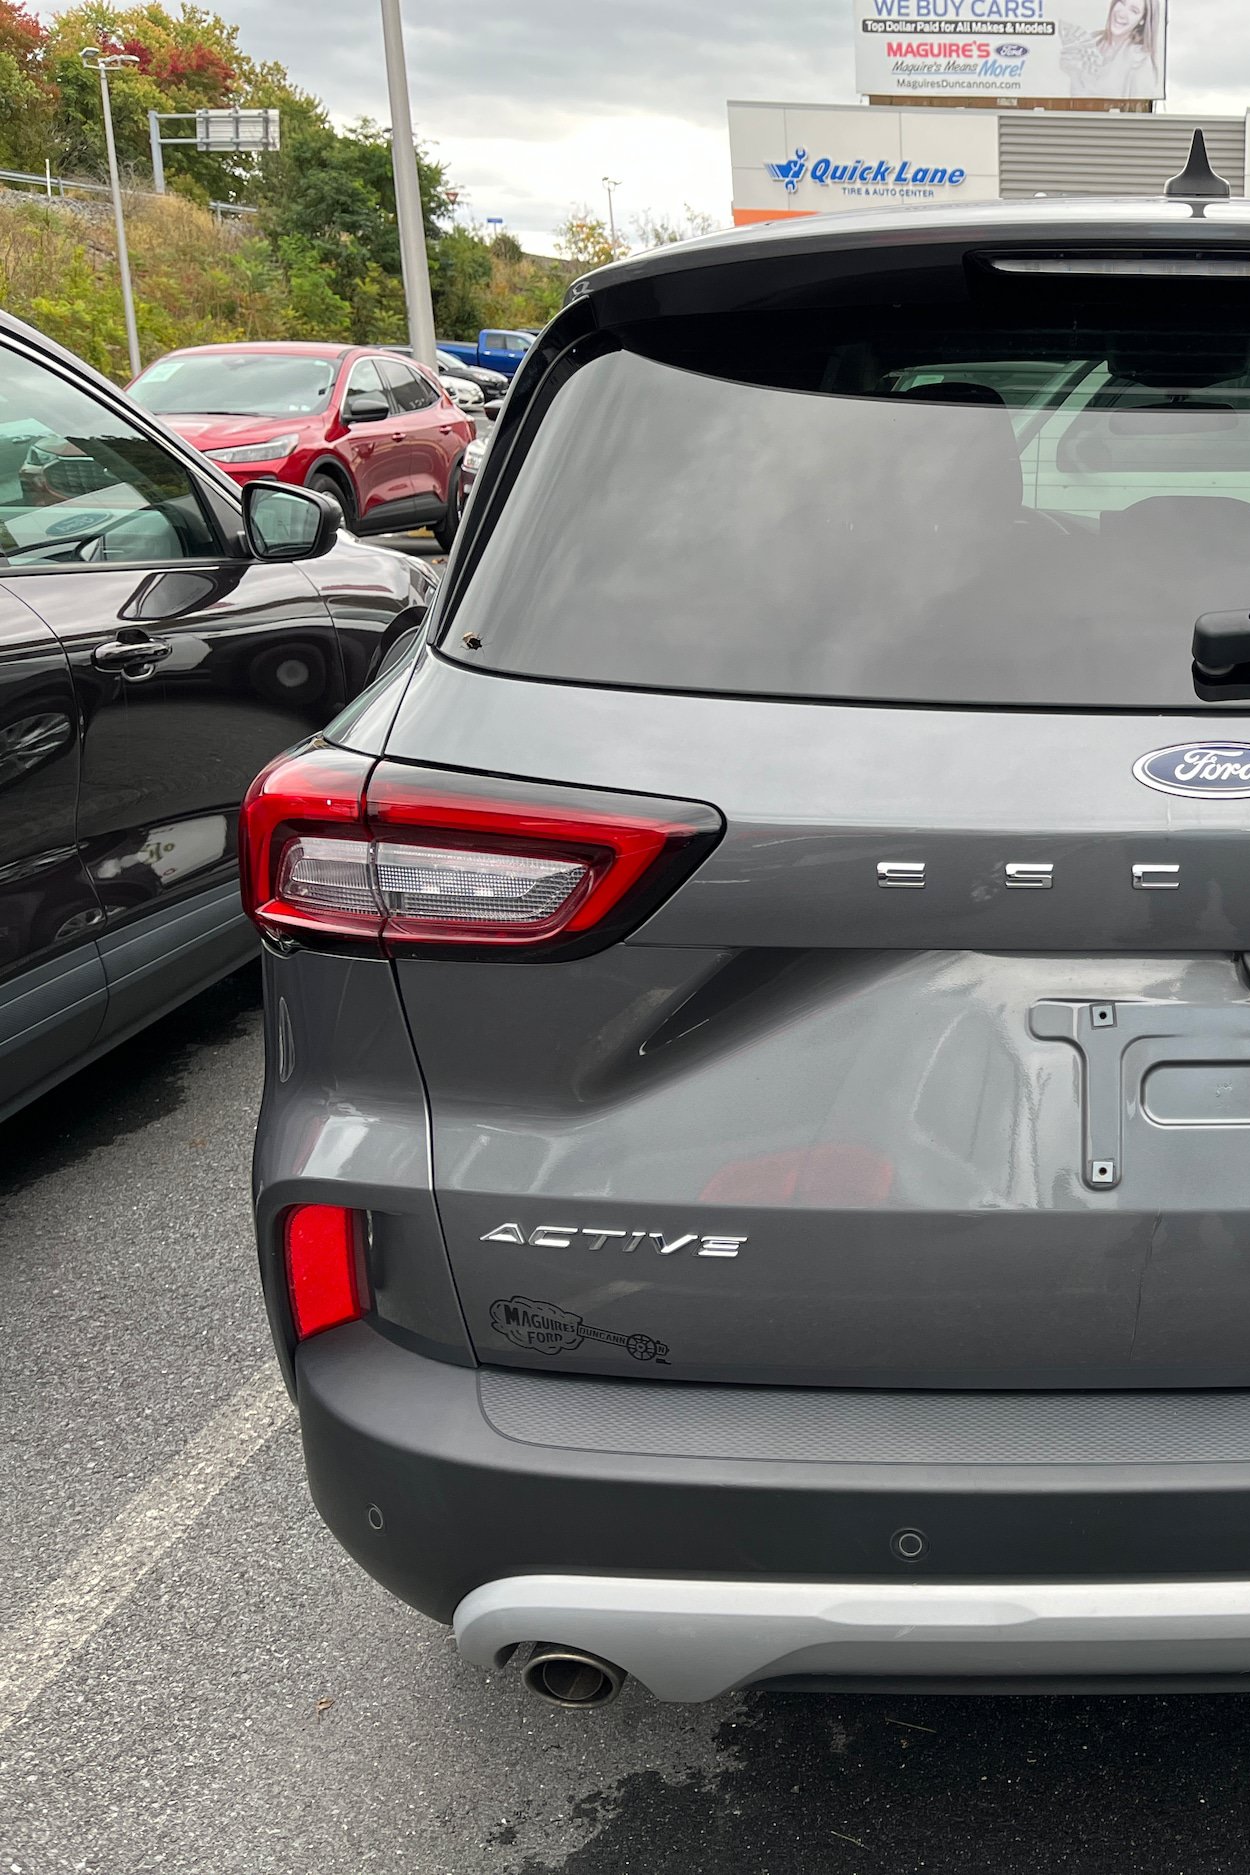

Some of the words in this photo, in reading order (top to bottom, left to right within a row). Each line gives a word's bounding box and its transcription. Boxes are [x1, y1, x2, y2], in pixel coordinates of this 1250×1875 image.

[874, 0, 910, 17] WE
[917, 0, 962, 18] BUY
[971, 0, 1044, 18] CARS!
[866, 20, 885, 32] Top
[886, 21, 915, 32] Dollar
[916, 21, 939, 33] Paid
[940, 21, 955, 33] for
[956, 22, 971, 33] All
[972, 22, 1004, 33] Makes
[1005, 22, 1014, 33] &
[1015, 22, 1053, 34] Models
[886, 40, 991, 59] MAGUIRE'S
[891, 60, 942, 76] Maguire's
[944, 61, 978, 72] Means
[978, 60, 1026, 77] More!
[896, 78, 1021, 90] MaguiresDuncannon.com
[809, 157, 893, 186] Quick
[894, 160, 967, 187] Lane
[842, 187, 862, 196] TIRE
[873, 188, 897, 197] AUTO
[899, 189, 935, 198] CENTER
[479, 1222, 748, 1257] ACTIVE
[503, 1304, 576, 1334] MAGUIRES
[527, 1330, 563, 1345] FORD
